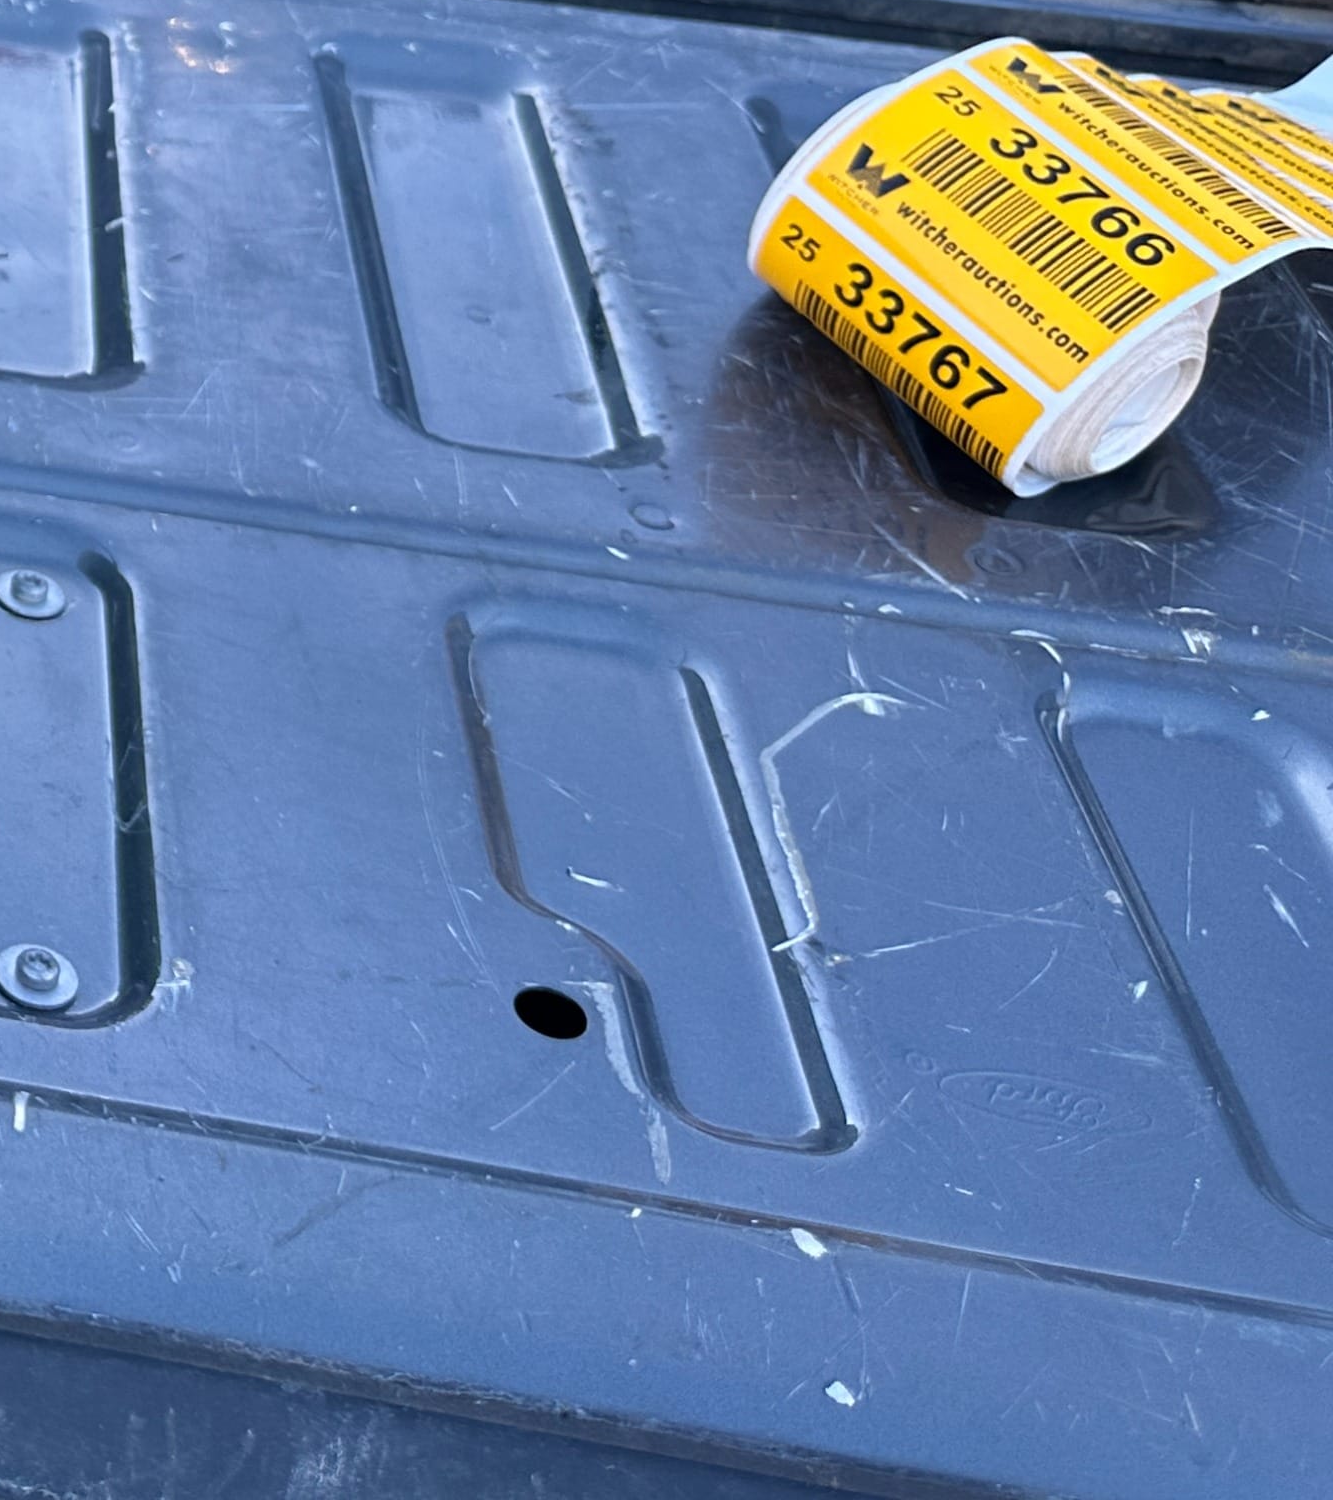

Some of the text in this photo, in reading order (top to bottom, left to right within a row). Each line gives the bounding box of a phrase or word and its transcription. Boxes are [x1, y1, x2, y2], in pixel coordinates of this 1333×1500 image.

[934, 85, 1177, 267] 25 33766
[1058, 102, 1255, 250] witcherauctions.com
[780, 224, 1008, 411] 25 33767
[896, 201, 1090, 364] witcherauctions.com
